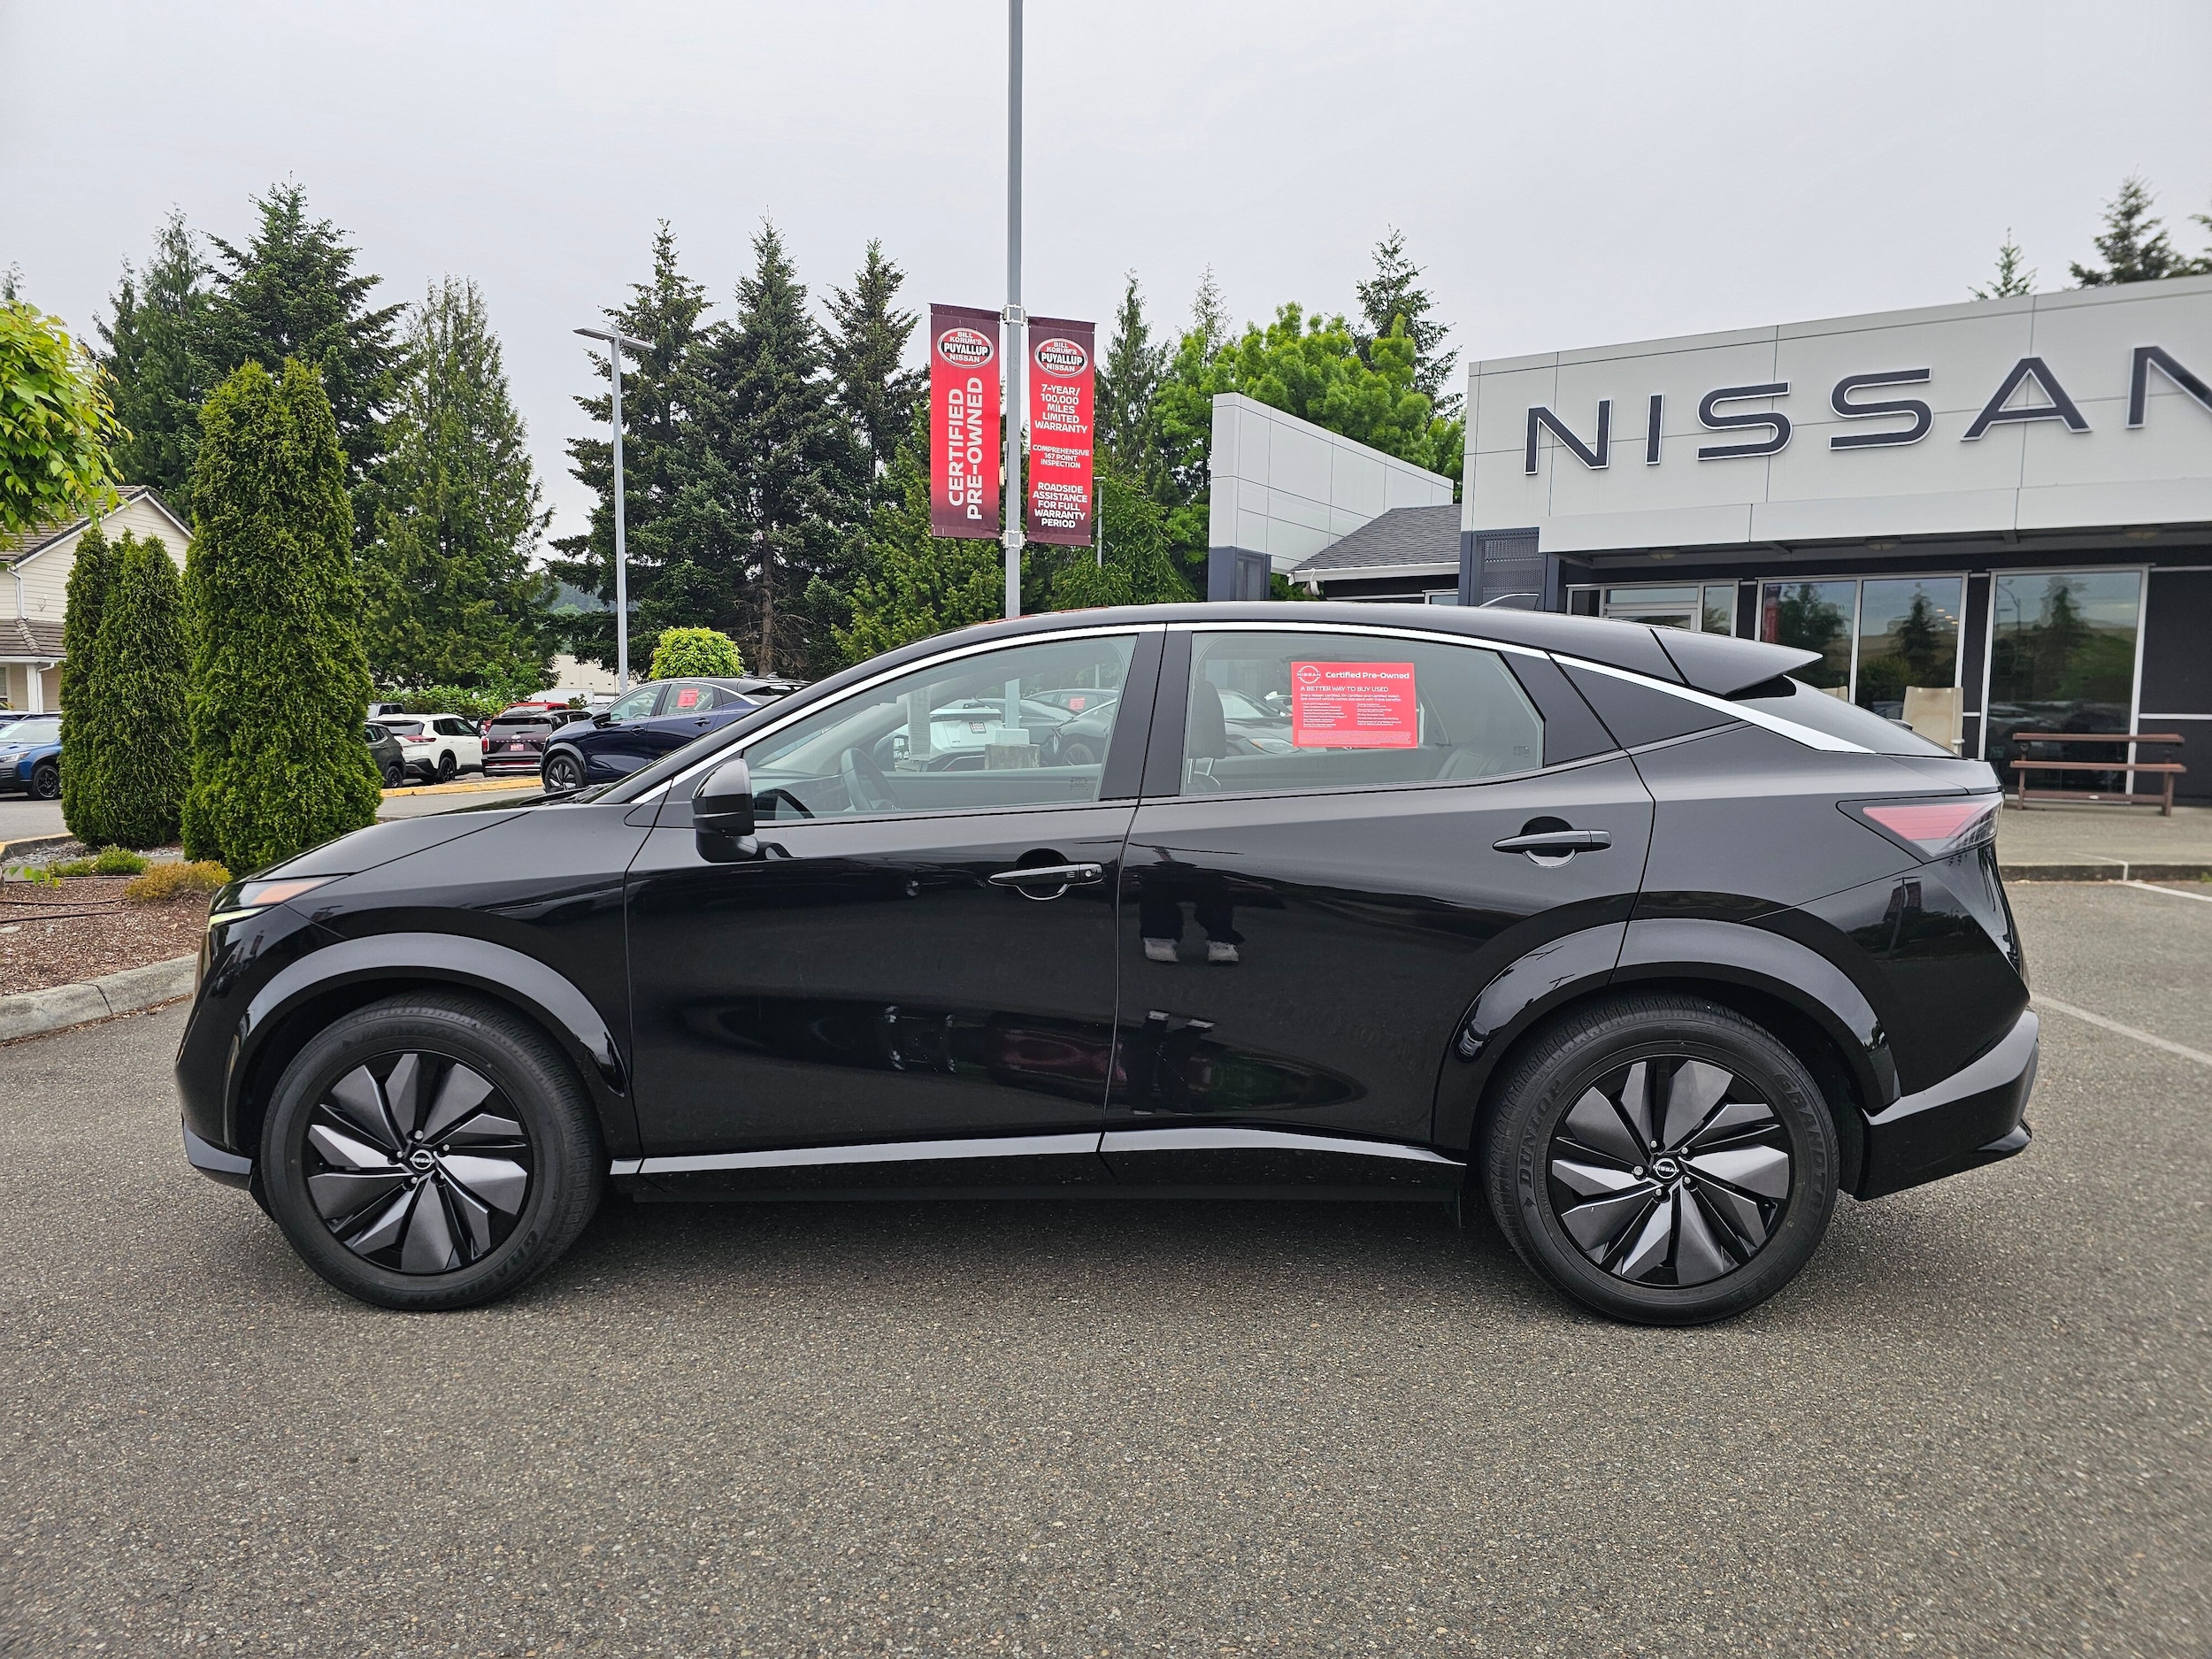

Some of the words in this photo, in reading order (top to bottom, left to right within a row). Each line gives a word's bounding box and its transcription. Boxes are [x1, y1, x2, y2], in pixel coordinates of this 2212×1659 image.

[949, 336, 982, 345] KORUM'S
[943, 342, 988, 357] PUYALLUP
[1046, 346, 1077, 355] KORUM'S
[949, 354, 980, 363] NISSAN
[1041, 352, 1083, 366] PUYALLUP
[1046, 363, 1075, 373] NISSAN
[1041, 384, 1080, 396] 7-YEAR/
[1041, 394, 1079, 405] 100,000
[1047, 403, 1075, 414] MILES
[1524, 345, 2212, 475] NISSAN
[1042, 411, 1079, 424] LIMITED
[1034, 420, 1088, 434] WARRANTY
[949, 388, 964, 506] CERTIFIED
[966, 377, 983, 520] PRE-OWNED
[1033, 444, 1090, 457] COMPREHENSIVE
[1041, 459, 1081, 469] INSPECTION
[1038, 482, 1083, 494] ROADSIDE
[1033, 491, 1088, 503] ASSISTANCE
[1038, 500, 1056, 509] FOR
[1057, 502, 1080, 511] FULL
[1034, 509, 1086, 520] WARRANTY
[1041, 518, 1076, 528] PERIOD
[1519, 1078, 1562, 1189] DUNLOP
